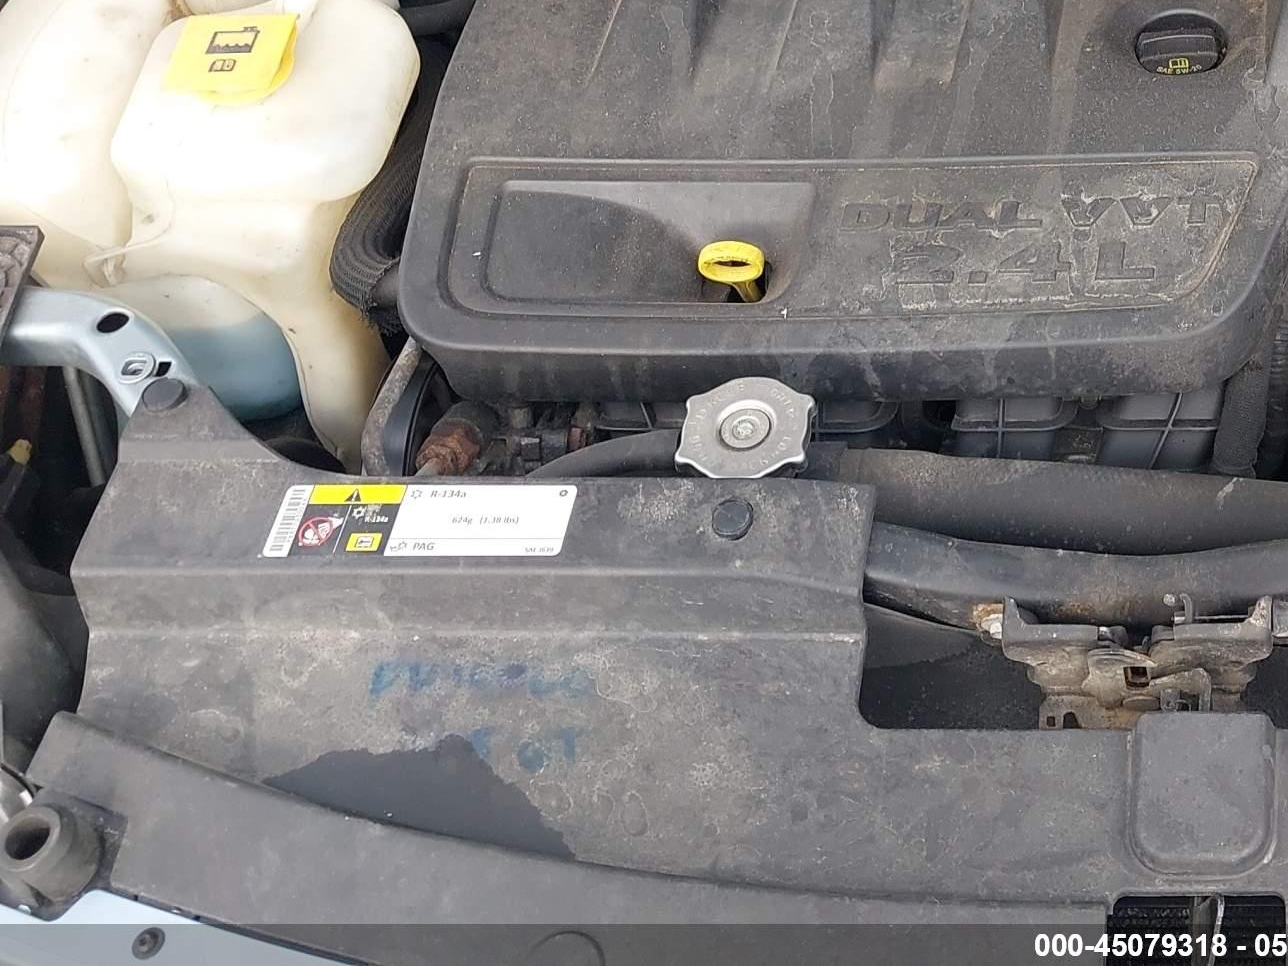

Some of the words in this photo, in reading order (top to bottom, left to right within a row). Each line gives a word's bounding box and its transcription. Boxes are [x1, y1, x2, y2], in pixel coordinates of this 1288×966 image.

[842, 200, 1043, 231] DUAL
[1061, 195, 1221, 227] VVT
[893, 240, 1156, 284] 2.4L
[430, 490, 467, 498] R-134a
[412, 542, 436, 550] PAG
